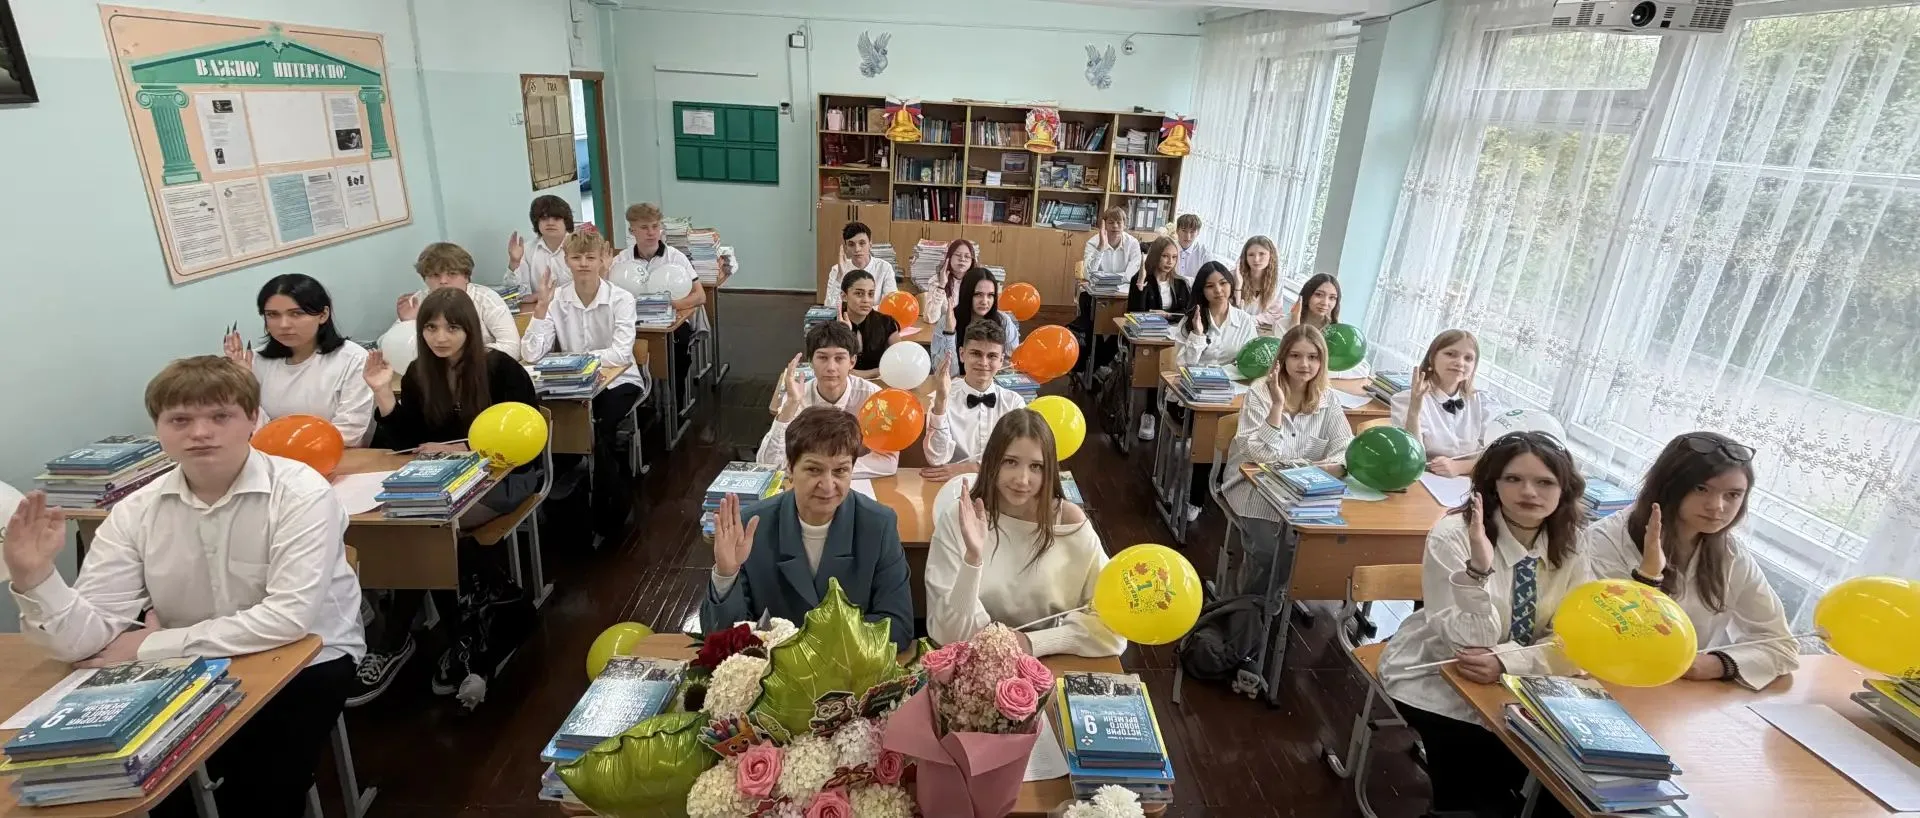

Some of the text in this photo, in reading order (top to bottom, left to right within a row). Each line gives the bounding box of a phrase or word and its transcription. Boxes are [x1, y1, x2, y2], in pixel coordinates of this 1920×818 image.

[195, 58, 347, 79] ВАЖНО! ИНТЕРЕСНО!
[40, 707, 74, 729] 9
[1083, 715, 1098, 735] 9
[1103, 715, 1138, 724] ВРЕМЕНИ
[1105, 727, 1142, 736] ИСТОРИЯ
[1109, 722, 1140, 730] НОВОГО
